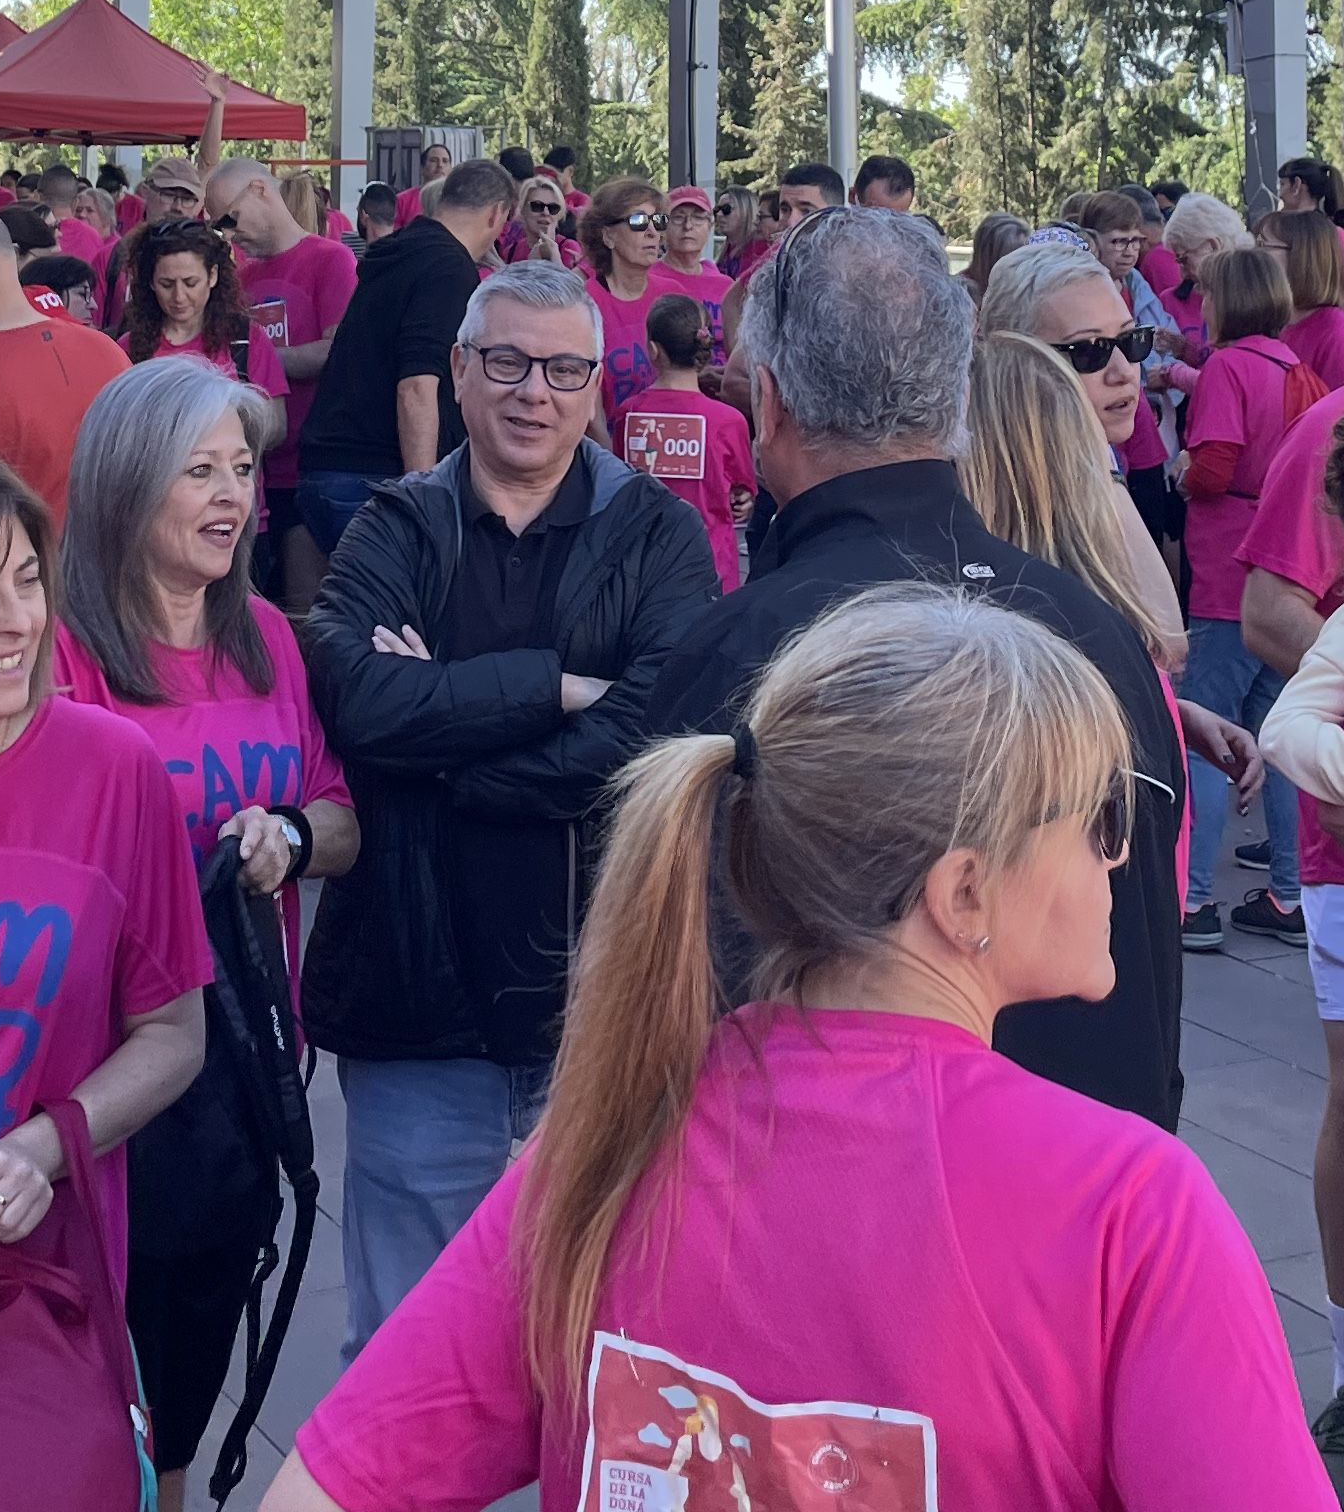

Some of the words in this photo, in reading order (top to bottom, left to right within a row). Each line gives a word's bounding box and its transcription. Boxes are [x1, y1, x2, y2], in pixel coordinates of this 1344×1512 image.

[663, 438, 701, 457] 000
[608, 1467, 652, 1487] CURSA
[609, 1482, 627, 1496] DE
[630, 1484, 646, 1500] LA
[609, 1497, 645, 1512] DONA
